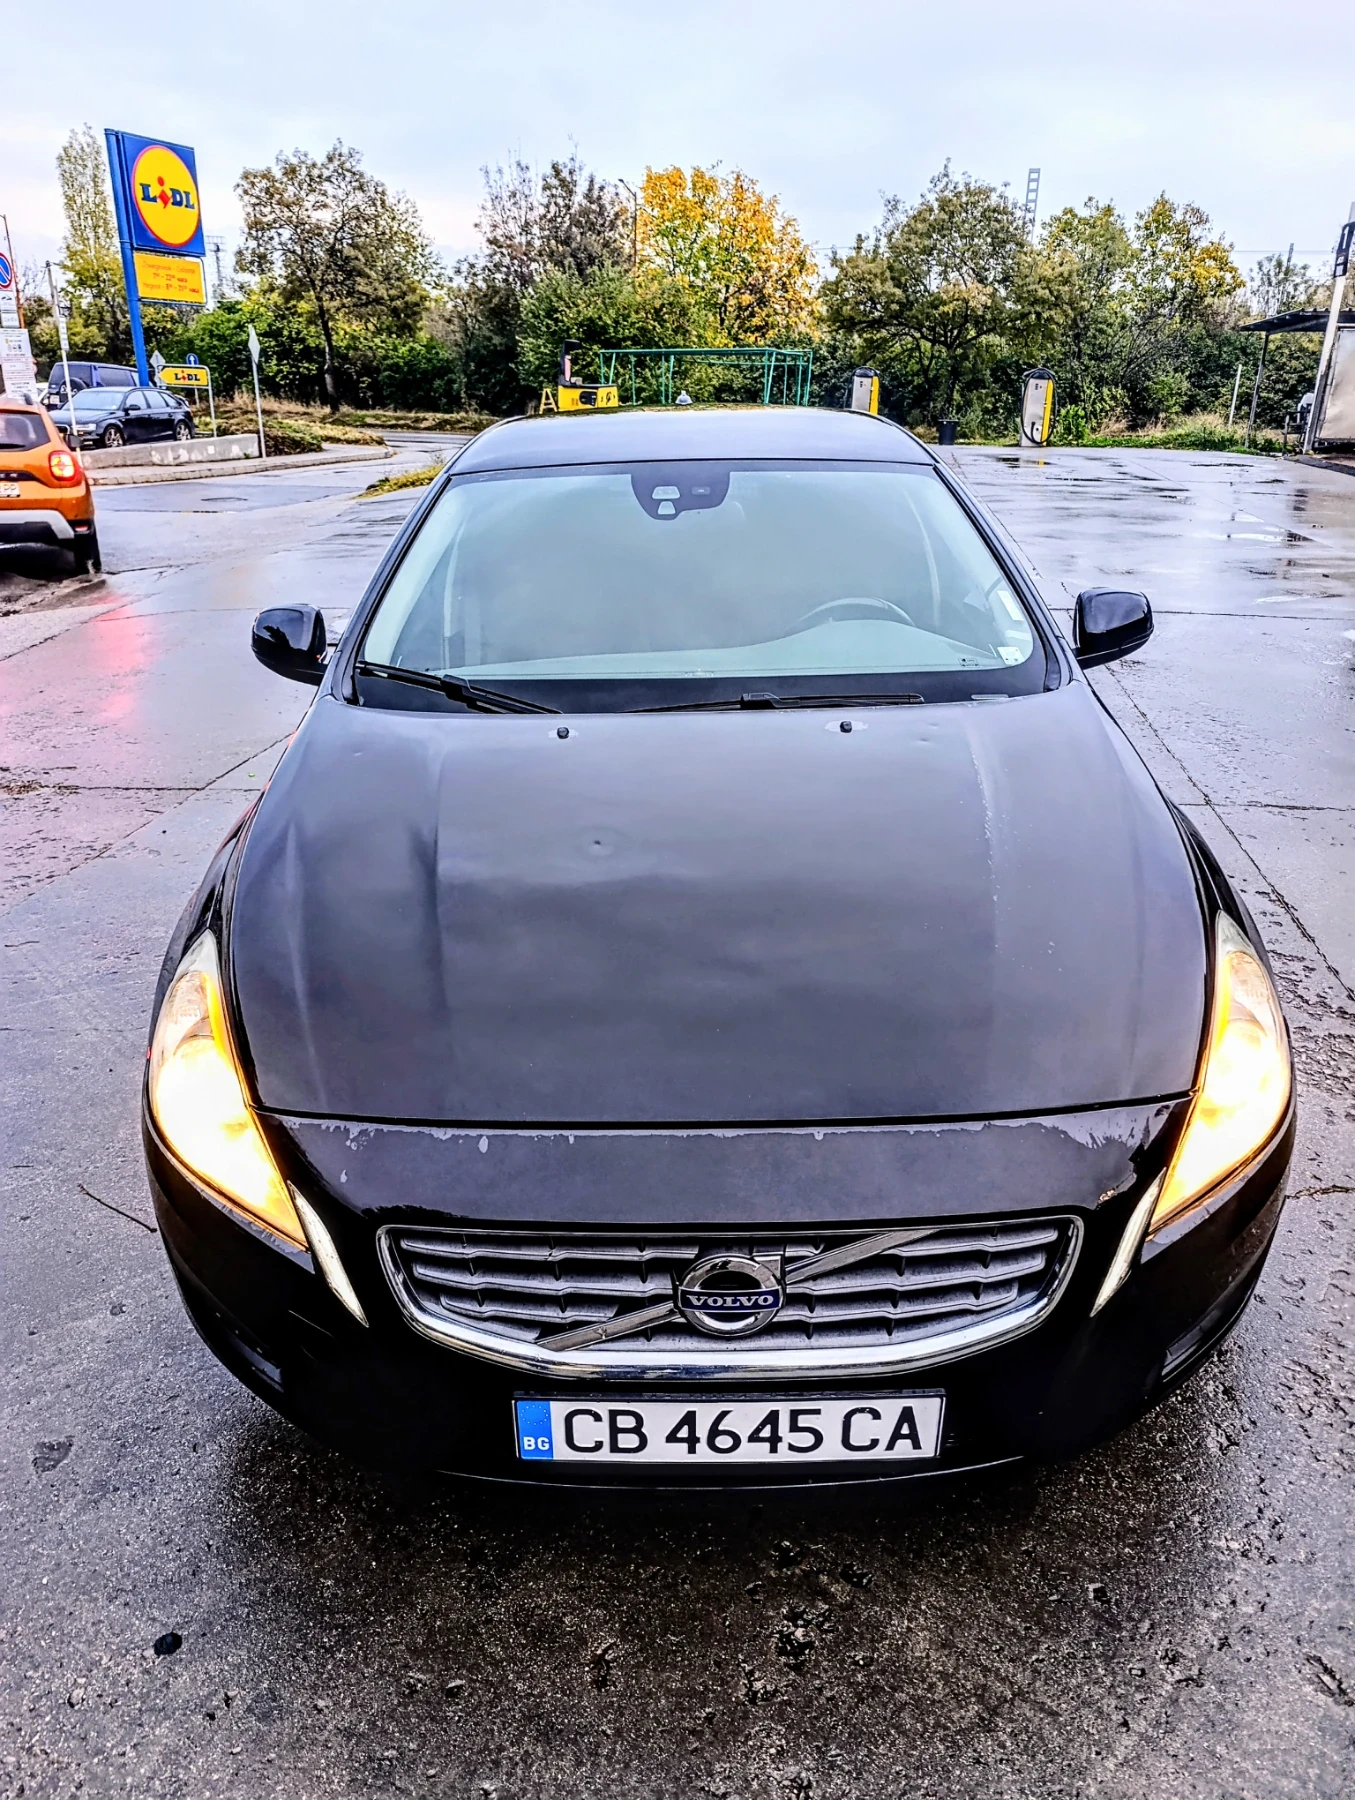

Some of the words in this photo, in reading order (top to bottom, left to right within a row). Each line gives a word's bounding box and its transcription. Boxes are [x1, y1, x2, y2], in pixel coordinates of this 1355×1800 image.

[686, 1295, 774, 1307] VOLVO
[523, 1437, 550, 1451] BG
[564, 1408, 648, 1454] CB
[665, 1408, 825, 1455] 4645
[841, 1406, 922, 1452] CA
